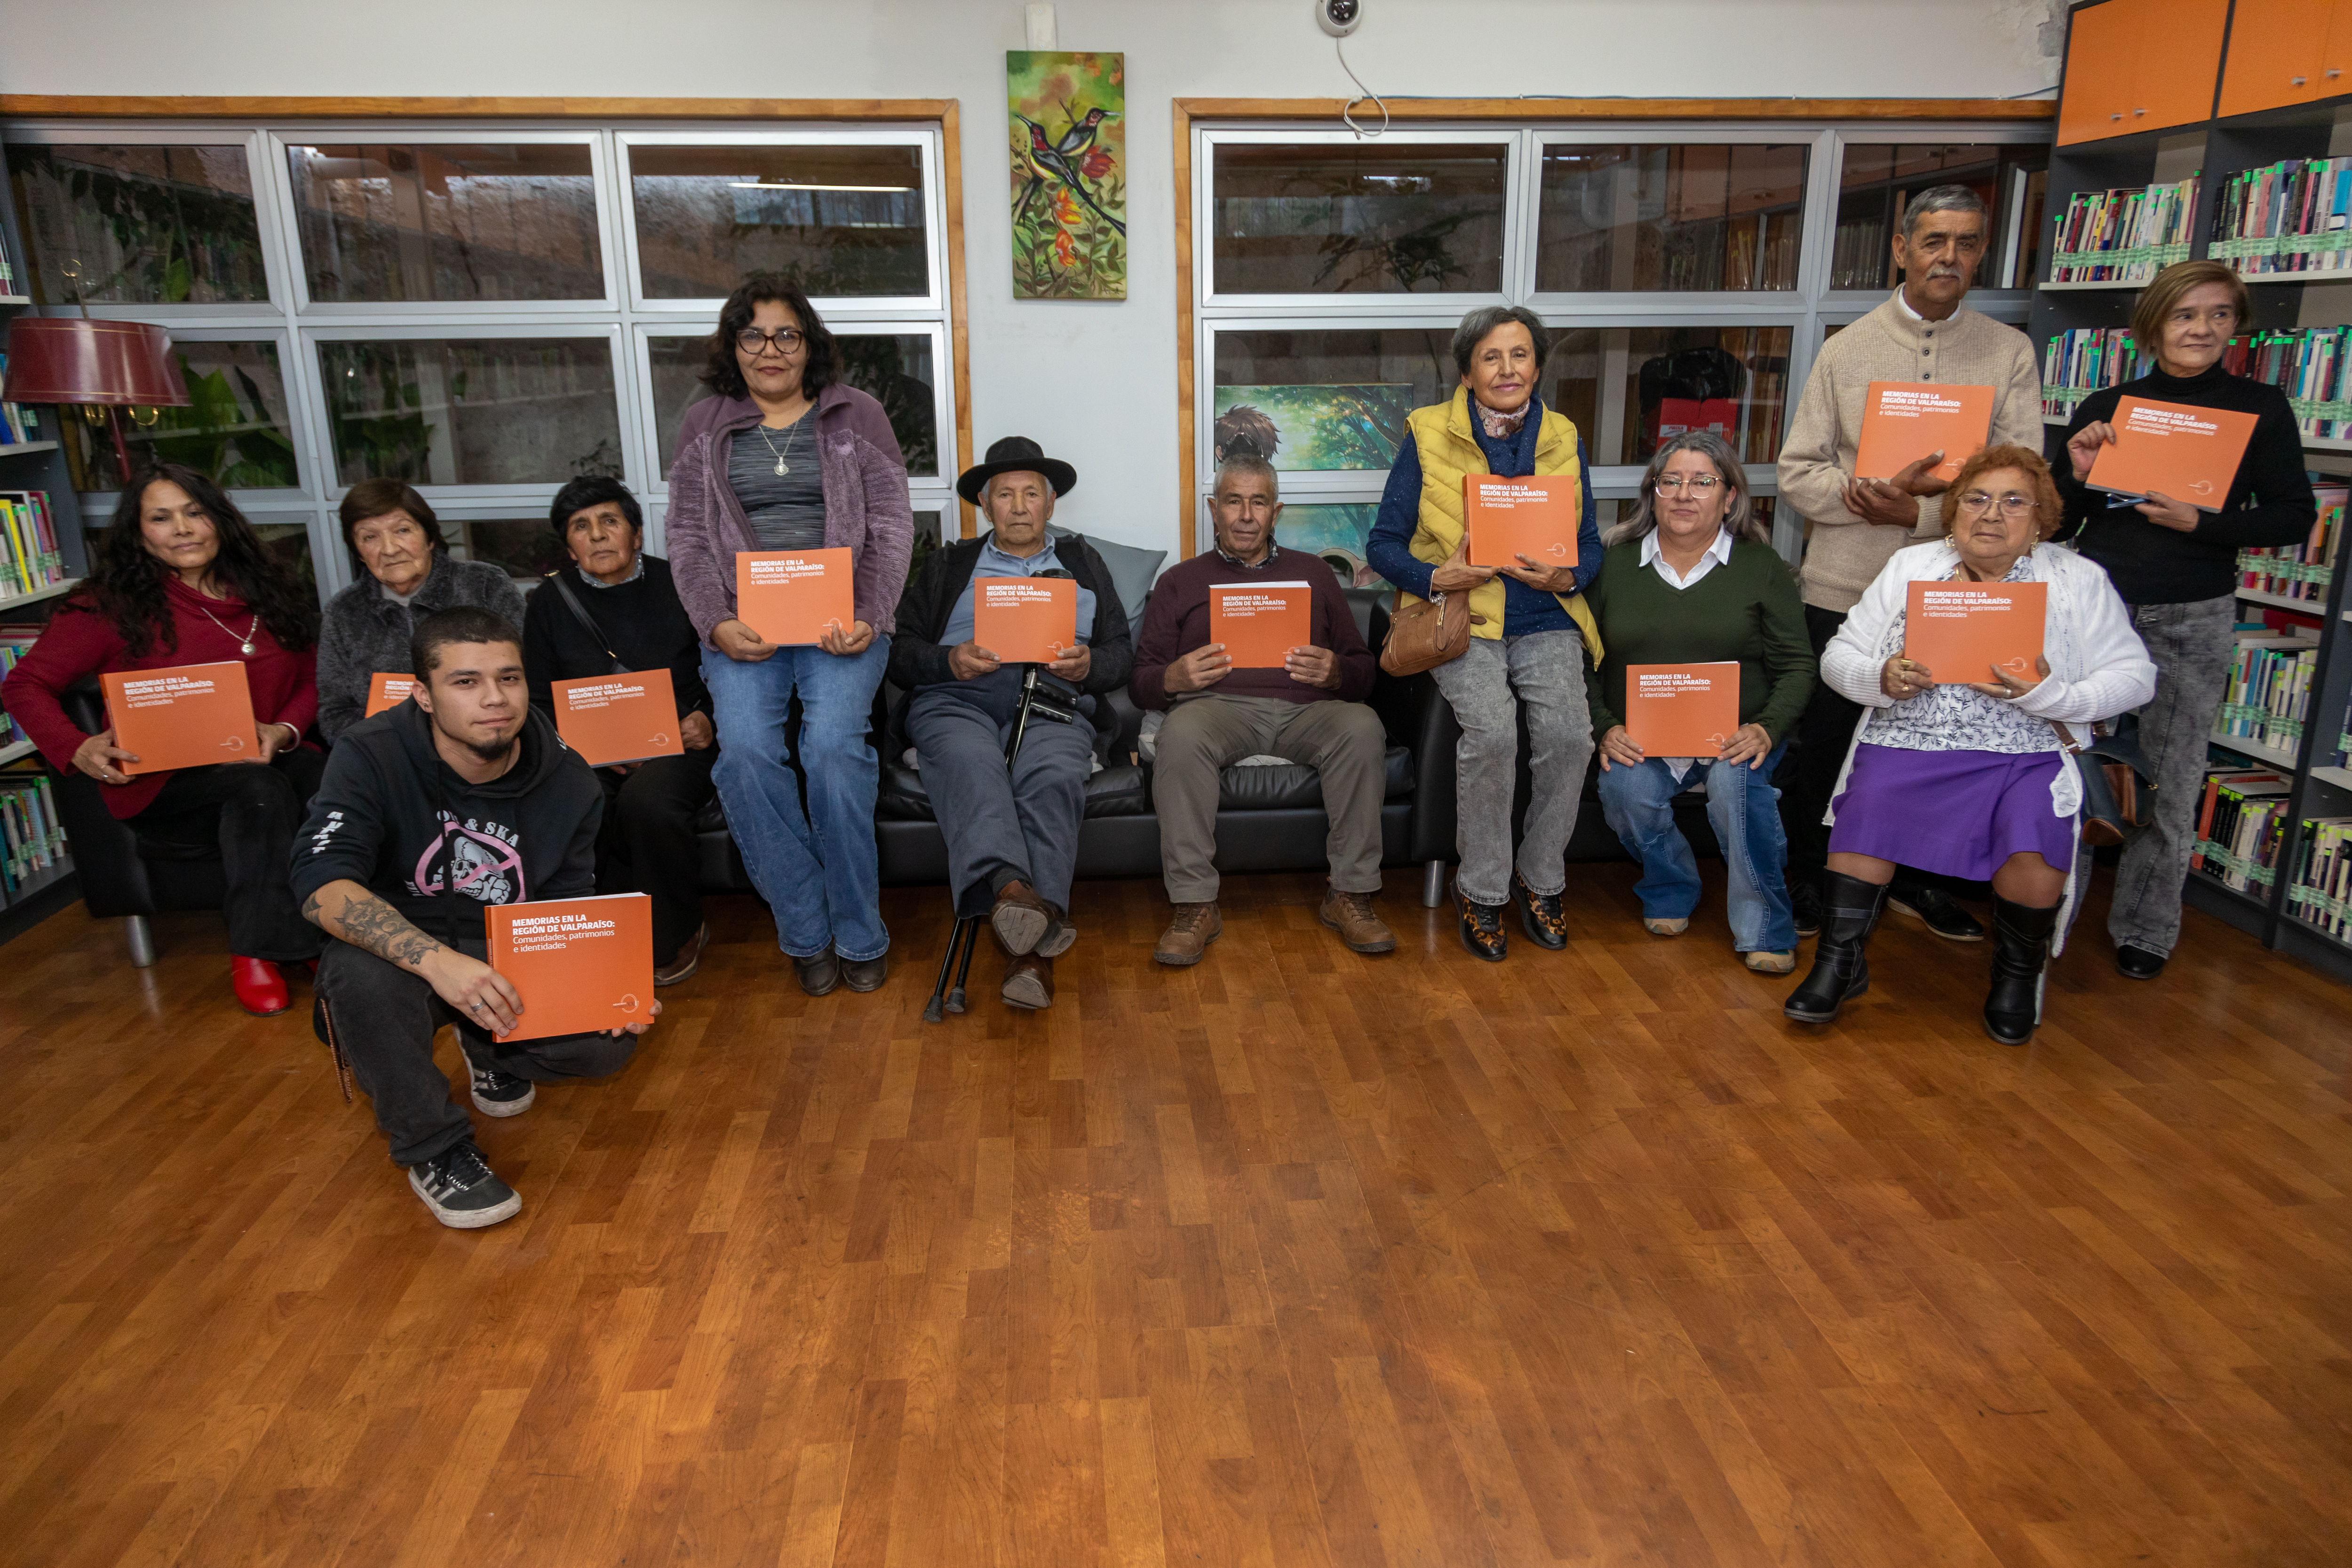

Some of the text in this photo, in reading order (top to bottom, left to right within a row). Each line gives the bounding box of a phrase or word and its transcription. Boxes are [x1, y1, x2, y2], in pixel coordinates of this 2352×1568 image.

[568, 685, 603, 694] MEMORIAS
[604, 686, 644, 695] VALPARAÍSO:
[569, 692, 644, 705] Comunidades, patrimonios
[575, 701, 609, 710] identidades
[464, 819, 478, 831] &
[484, 822, 519, 847] SKA
[512, 916, 560, 927] MEMORIAS
[513, 925, 546, 935] REGIÓN
[561, 919, 615, 931] VALPARAÍSO:
[513, 930, 614, 944] Comunidades, patrimonios
[520, 942, 566, 952] identidades
